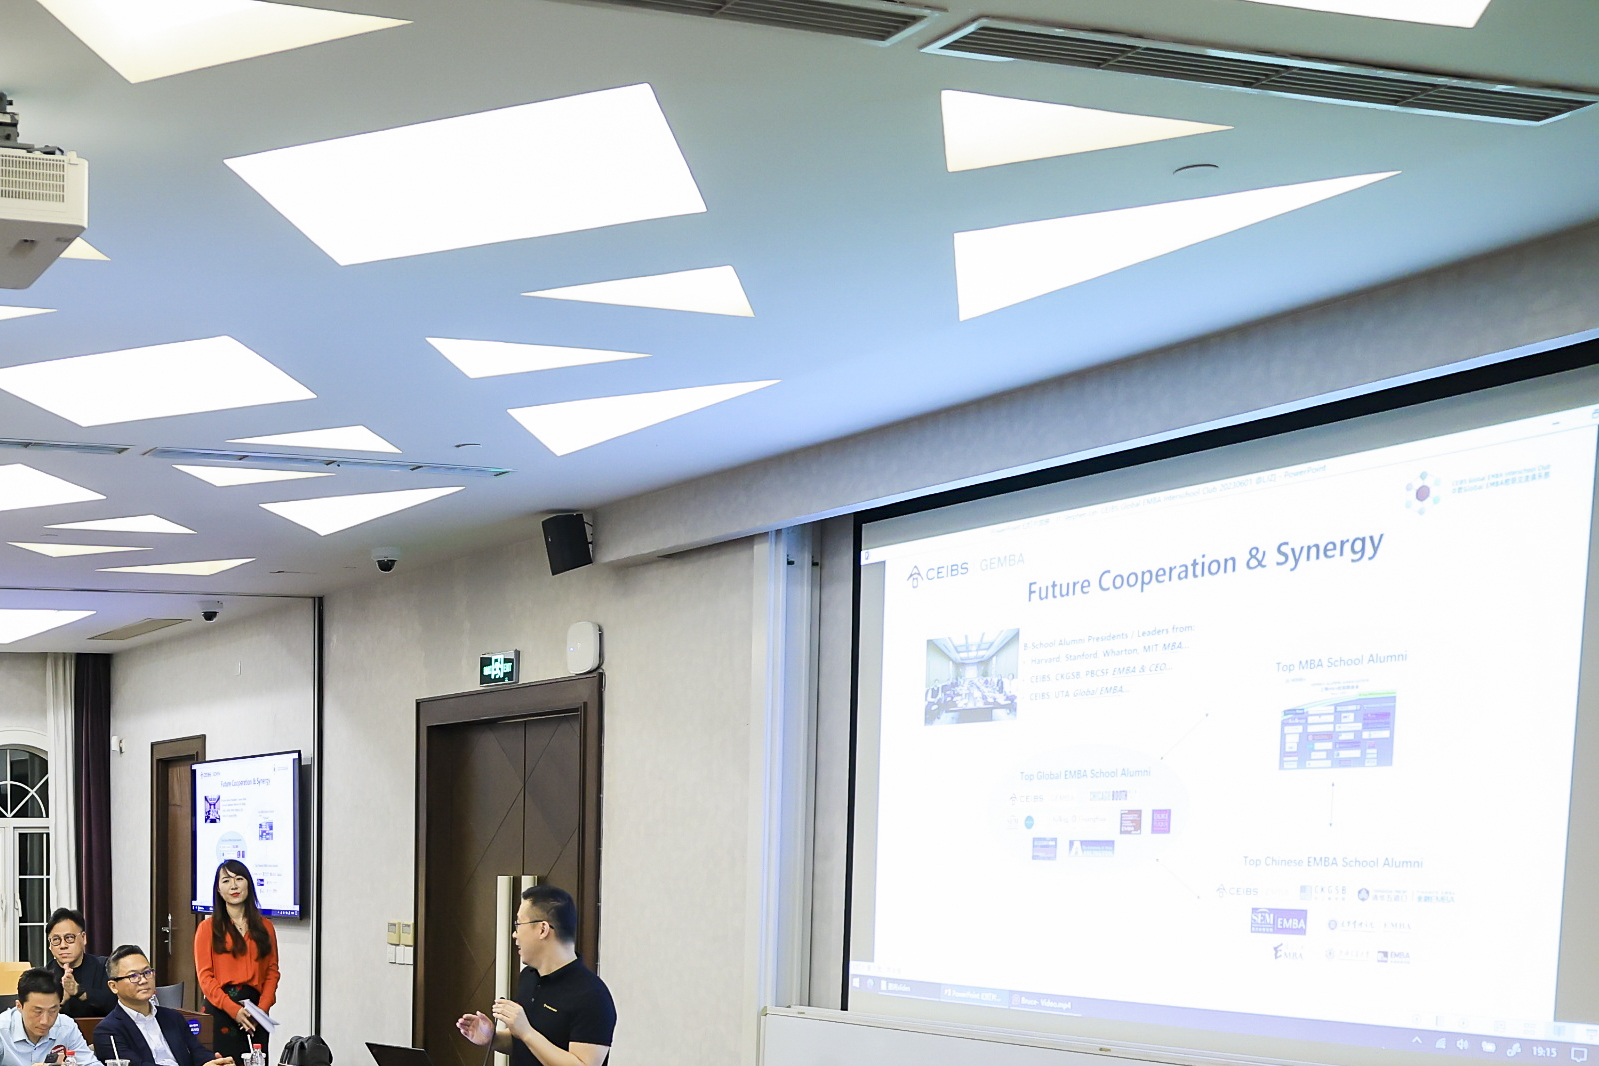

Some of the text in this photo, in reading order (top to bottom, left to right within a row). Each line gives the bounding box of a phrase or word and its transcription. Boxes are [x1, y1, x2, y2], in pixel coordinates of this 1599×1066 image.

[1202, 485, 1218, 495] Club
[1284, 464, 1327, 478] PowerPoint
[925, 552, 1026, 582] CEIBS GEMBA
[1028, 532, 1385, 602] Future Cooperation & Synergy
[1058, 638, 1086, 646] Alumni
[1087, 632, 1128, 643] Presidents
[1138, 628, 1169, 638] Leaders
[1142, 644, 1159, 652] MIT
[1276, 650, 1408, 674] Top MBA School Alumni
[1112, 665, 1136, 676] EMBA
[1138, 664, 1146, 673] &
[1073, 686, 1099, 698] Global
[1020, 766, 1152, 782] Top Global EMBA School Alumni
[1243, 856, 1424, 868] Top Chinese EMBA School Alumni
[1229, 888, 1259, 896] CEIBS
[1252, 912, 1273, 924] SEM
[1278, 917, 1306, 929] EMBA
[1390, 951, 1410, 960] EMBA
[1532, 1046, 1557, 1058] 19:15
